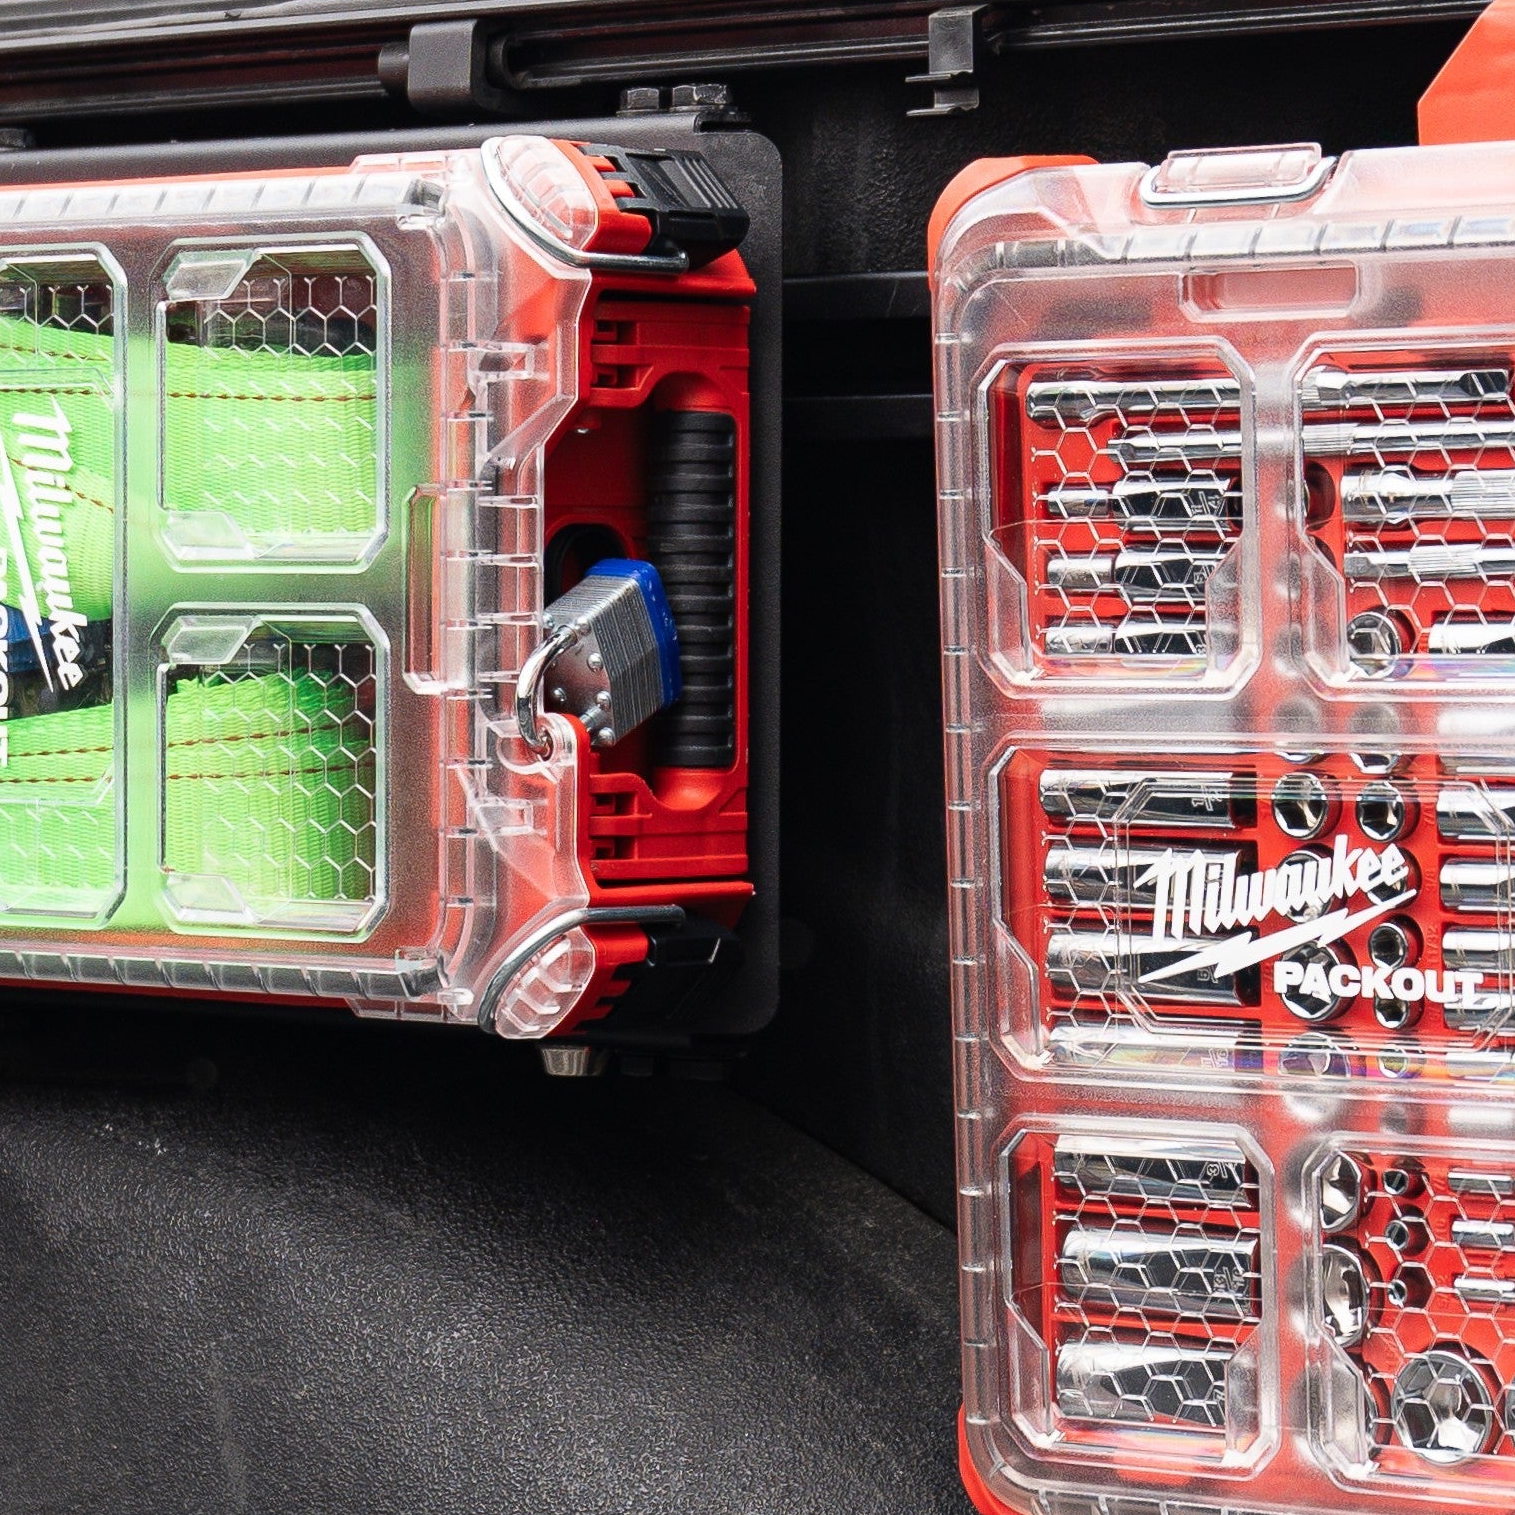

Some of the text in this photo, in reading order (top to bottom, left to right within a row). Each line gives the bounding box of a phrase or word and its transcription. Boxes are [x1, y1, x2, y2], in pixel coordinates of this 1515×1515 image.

[11, 393, 88, 692] Milwaukee
[1133, 833, 1409, 942] Milwaukee
[1272, 960, 1485, 1005] PACKOUT
